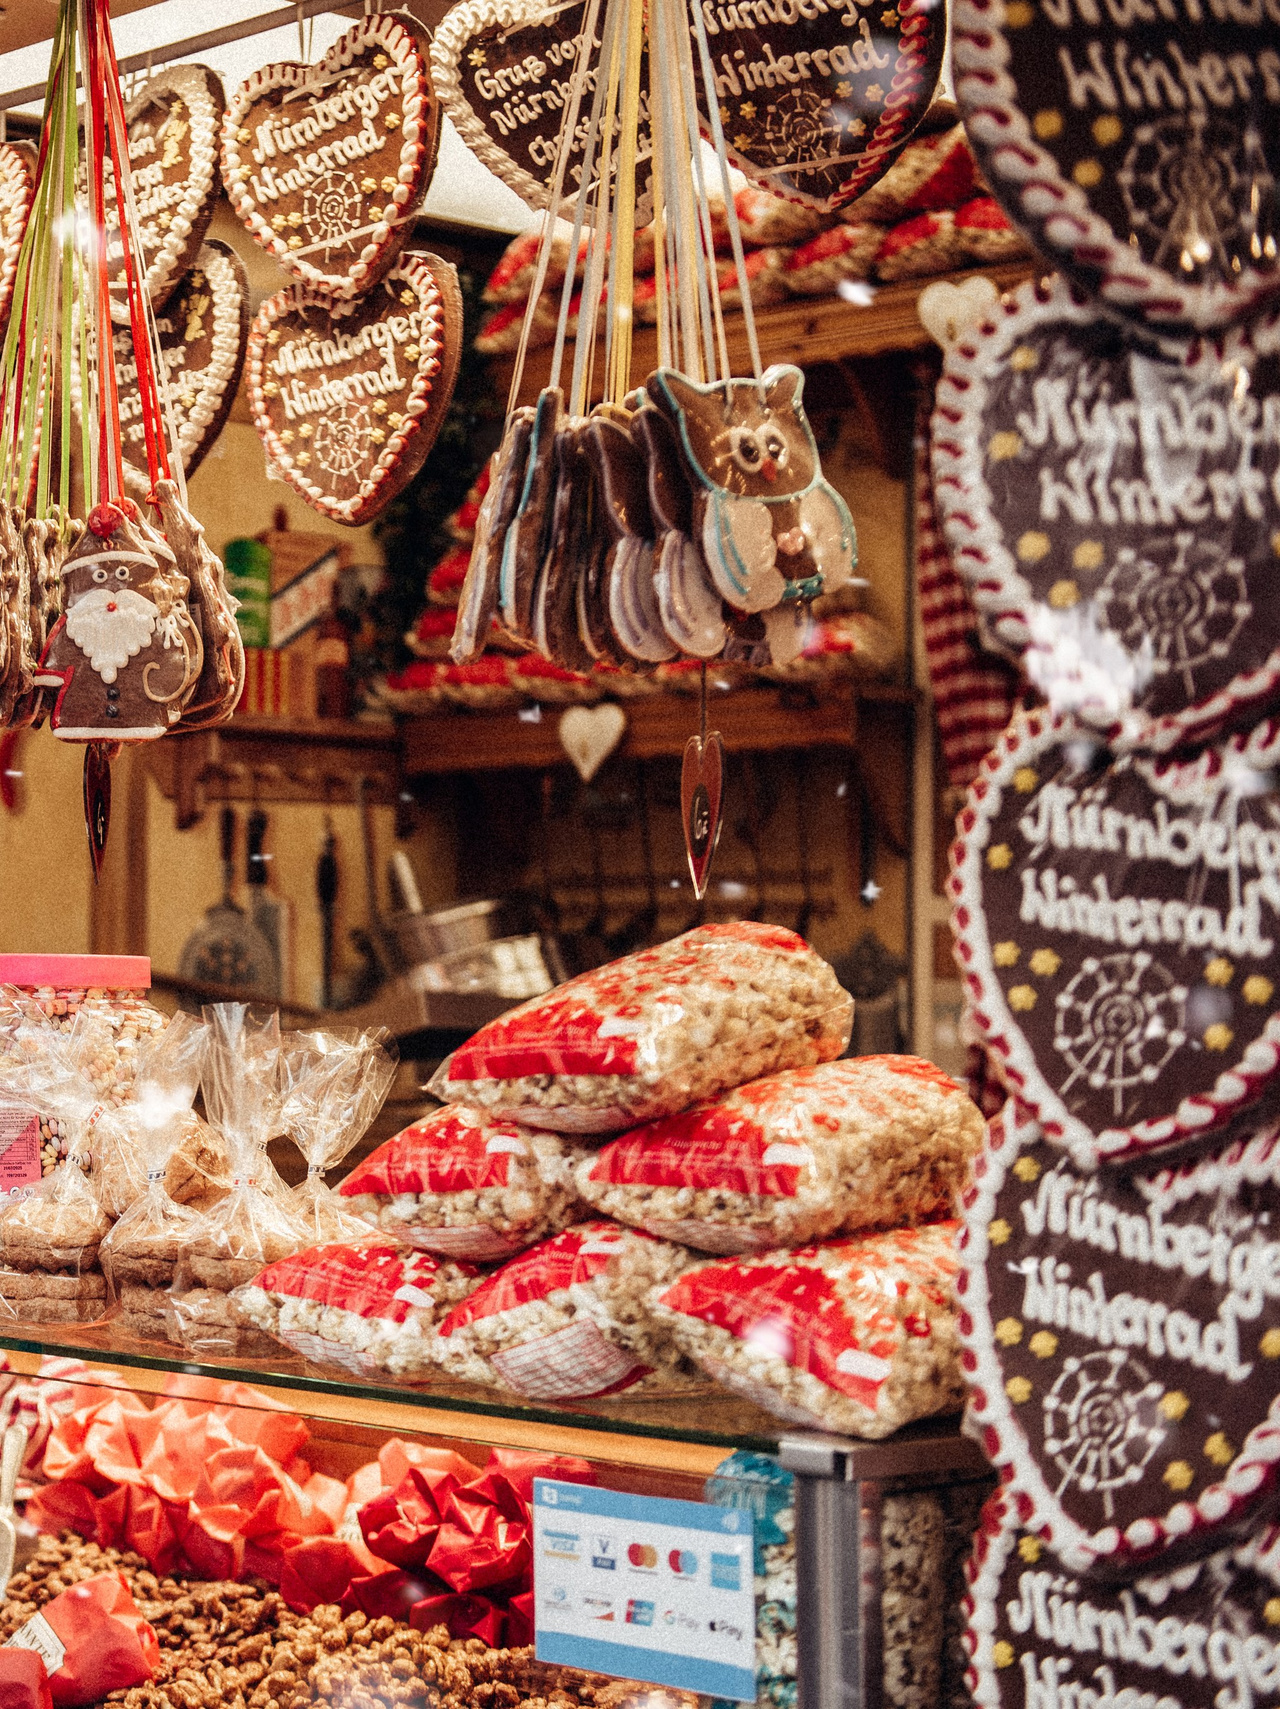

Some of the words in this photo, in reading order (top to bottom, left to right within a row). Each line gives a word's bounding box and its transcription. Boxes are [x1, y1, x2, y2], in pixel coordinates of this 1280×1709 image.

[475, 54, 547, 101] Gruß
[709, 18, 890, 97] Winterrad
[251, 66, 404, 164] Nürnberger
[249, 116, 387, 204] Winterrad
[270, 311, 424, 377] Nürnberger
[279, 357, 408, 420] Winterrad
[1020, 867, 1275, 959] Winterrad
